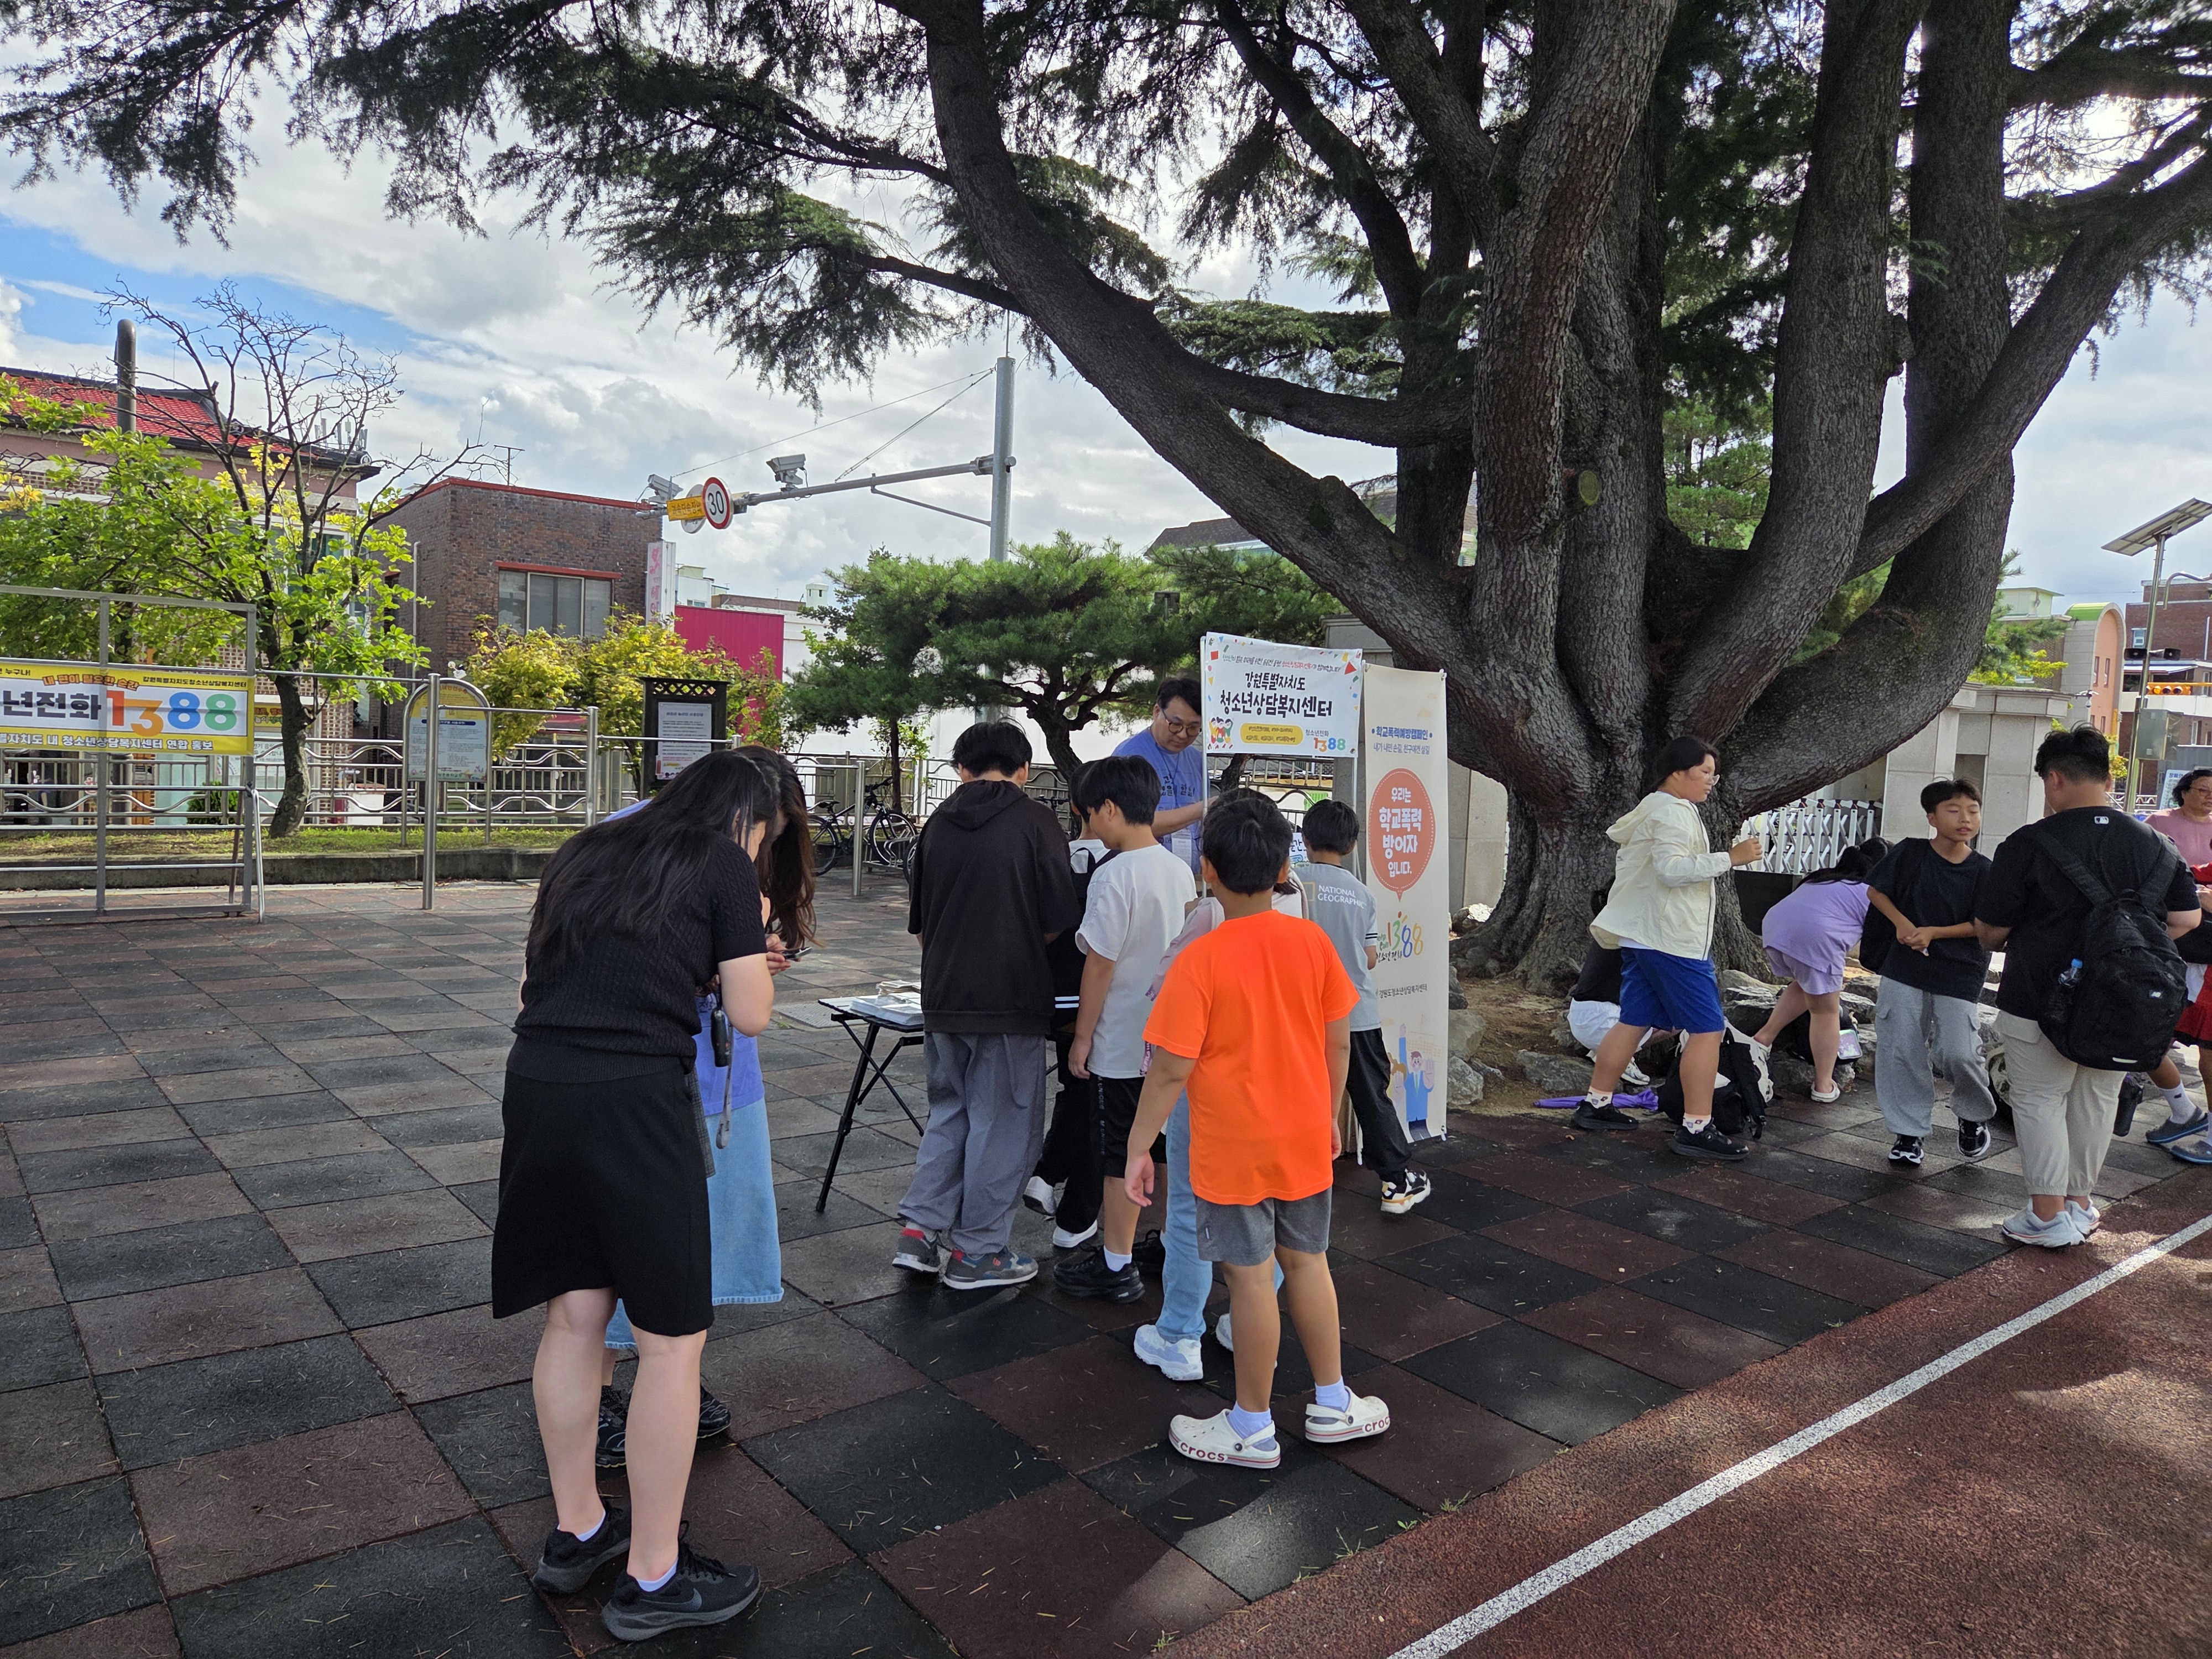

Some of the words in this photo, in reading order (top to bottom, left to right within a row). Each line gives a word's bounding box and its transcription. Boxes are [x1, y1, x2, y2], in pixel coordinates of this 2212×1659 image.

[708, 491, 725, 515] 30
[43, 676, 55, 686] 내
[58, 674, 80, 684] 편이
[82, 674, 116, 686] 필요한
[117, 678, 139, 691] 순간
[1245, 671, 1306, 691] 강원특별자치도
[3, 690, 102, 719] 년전화
[106, 690, 237, 737] 1388
[1220, 690, 1332, 718] 청소년상담복지센터
[47, 734, 58, 745] 내
[62, 734, 163, 749] 청소년상담복지센터
[166, 739, 189, 750] 연합
[192, 739, 213, 751] 홍보
[1376, 726, 1428, 740] 학교폭력예방캠페인
[1313, 737, 1346, 752] 1388
[1391, 787, 1411, 803] 우리는
[1379, 807, 1422, 832] 학교폭력
[1383, 834, 1418, 859] 방어자
[1317, 893, 1367, 909] GEOGRAPHIC
[1319, 885, 1357, 898] NATIONAL
[1387, 920, 1423, 958] 1388
[1180, 1442, 1225, 1462] crocs
